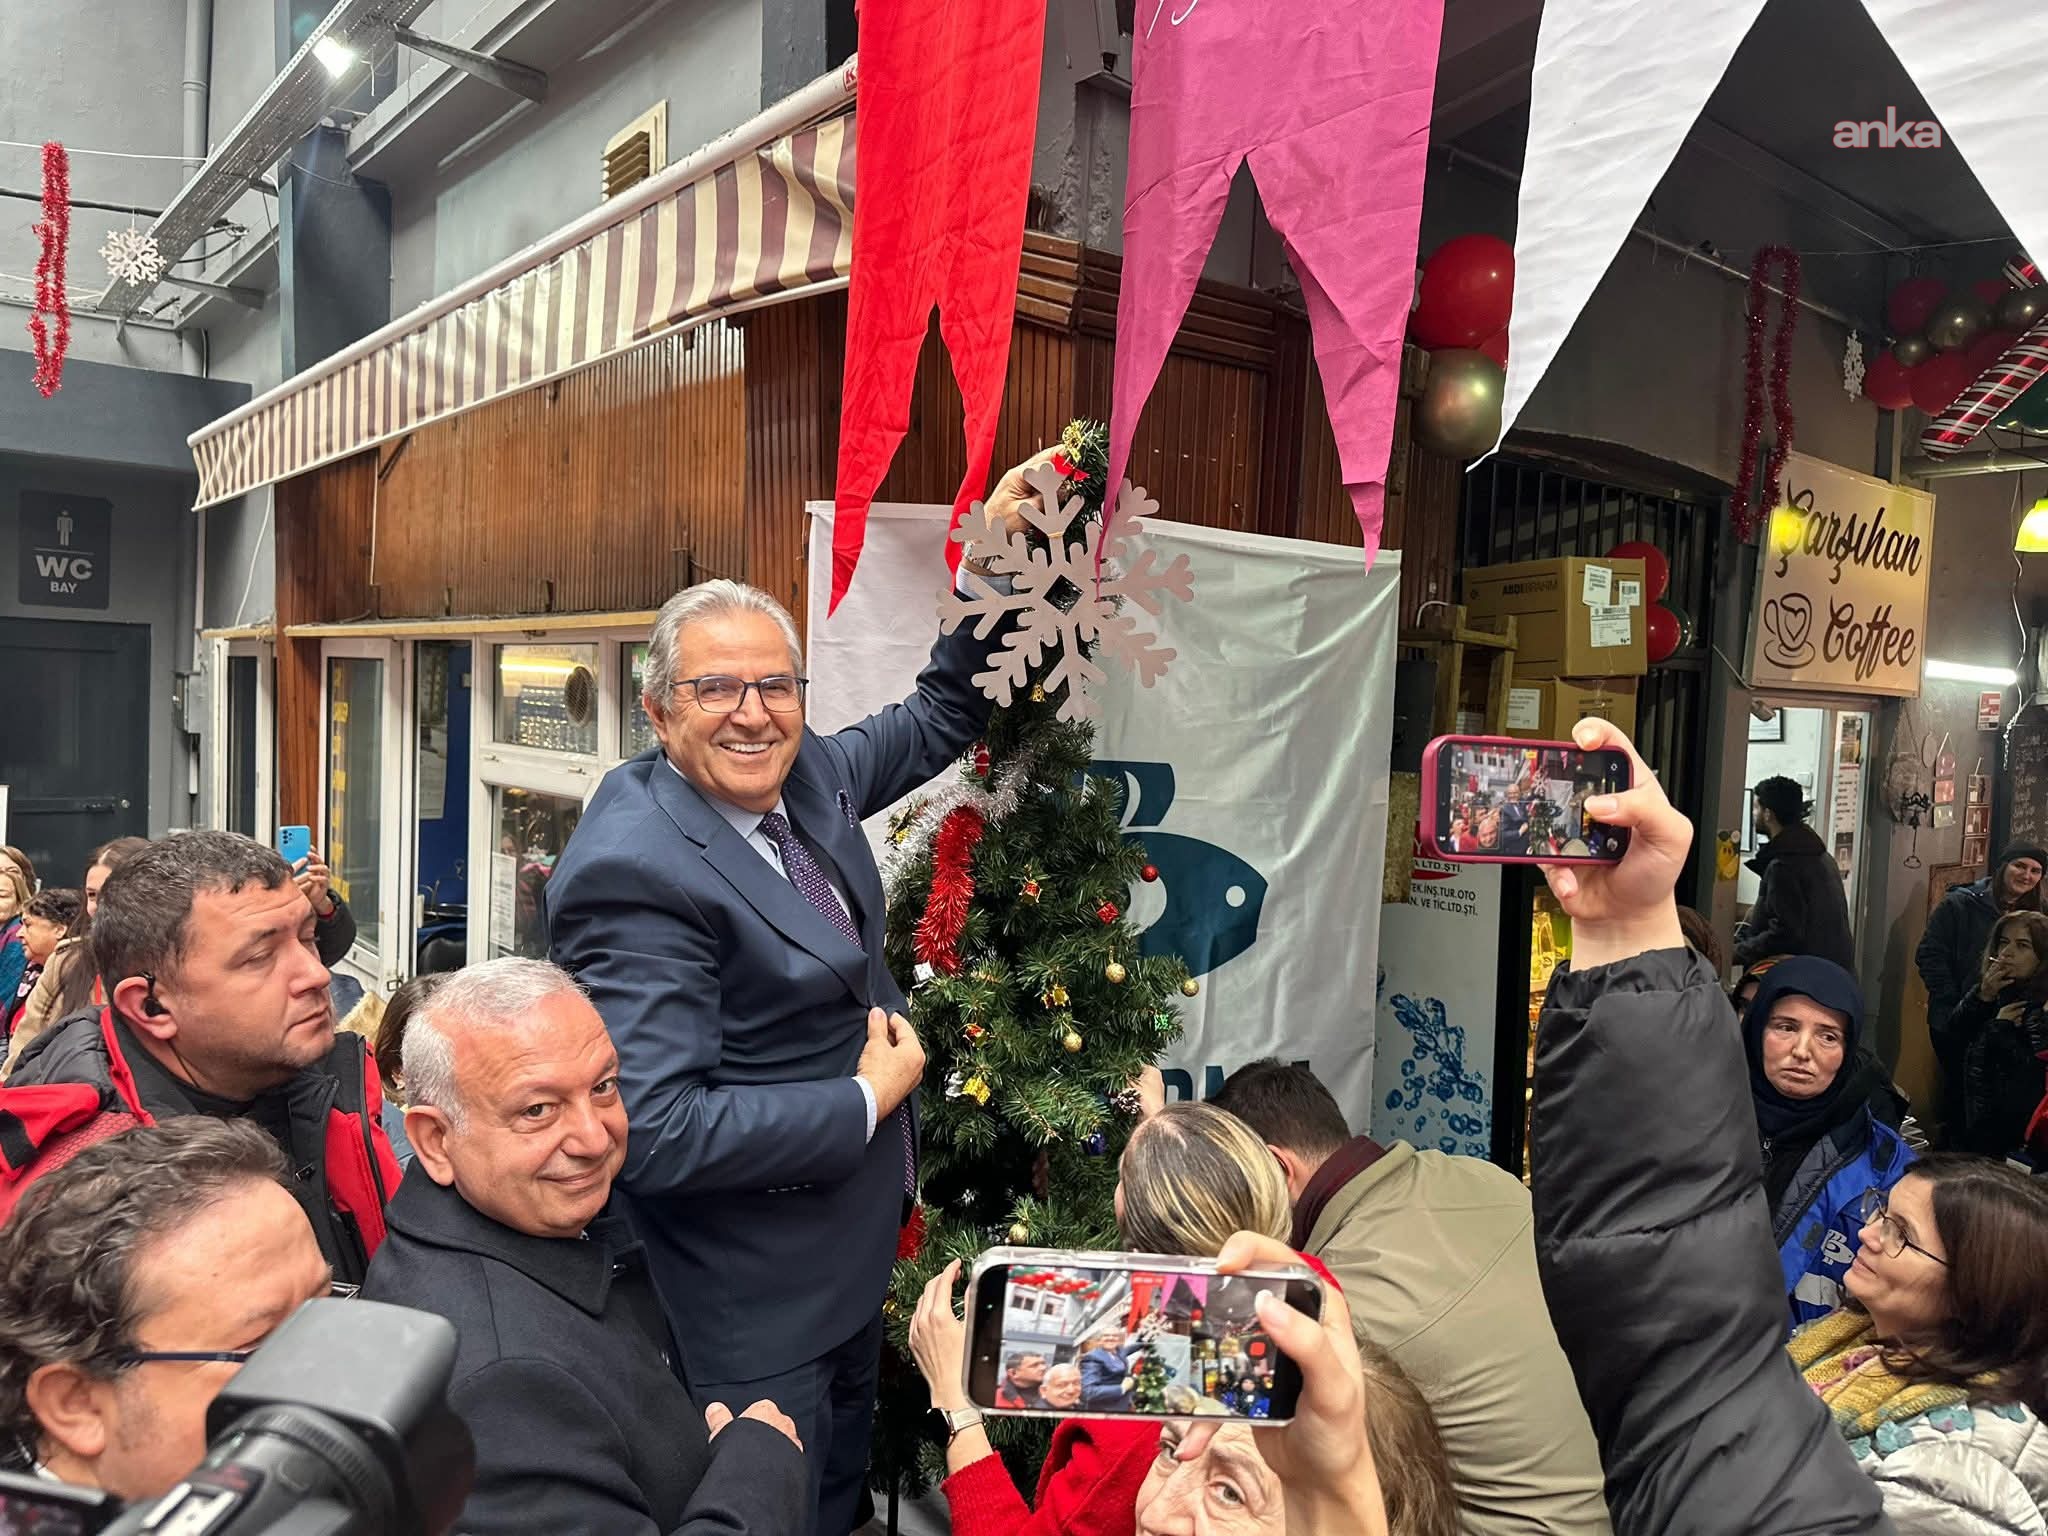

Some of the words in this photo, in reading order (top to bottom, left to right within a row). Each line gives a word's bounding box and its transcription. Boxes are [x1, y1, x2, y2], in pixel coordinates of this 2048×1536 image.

[1774, 480, 1922, 585] Çarşıhan
[35, 554, 93, 580] WC
[50, 581, 78, 594] BAY
[1822, 595, 1916, 682] Coffee
[1421, 898, 1431, 908] VE
